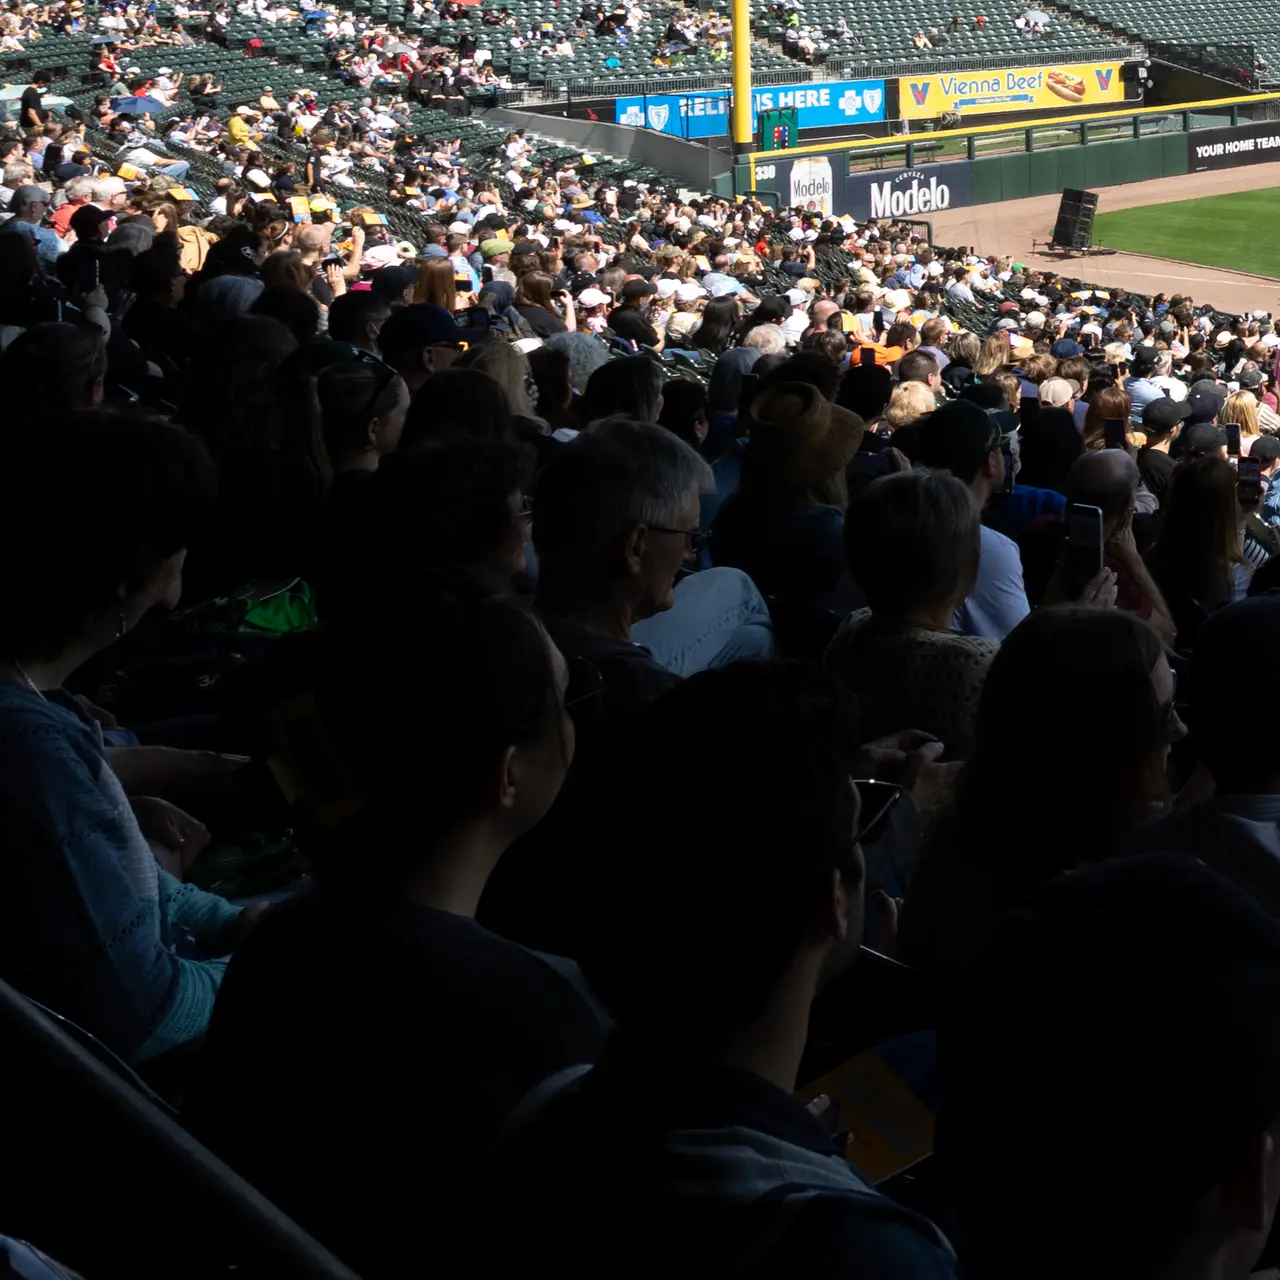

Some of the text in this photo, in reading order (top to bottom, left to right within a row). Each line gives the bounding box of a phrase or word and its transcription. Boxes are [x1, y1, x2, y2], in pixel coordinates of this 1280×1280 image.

[940, 71, 1043, 95] Vienna Beef
[679, 88, 831, 117] RELI IS HERE
[1196, 144, 1224, 158] YOUR
[1225, 139, 1255, 154] HOME
[755, 165, 776, 180] 330
[895, 171, 925, 183] CERVEZA
[794, 177, 830, 197] Modelo
[870, 176, 950, 218] Modelo
